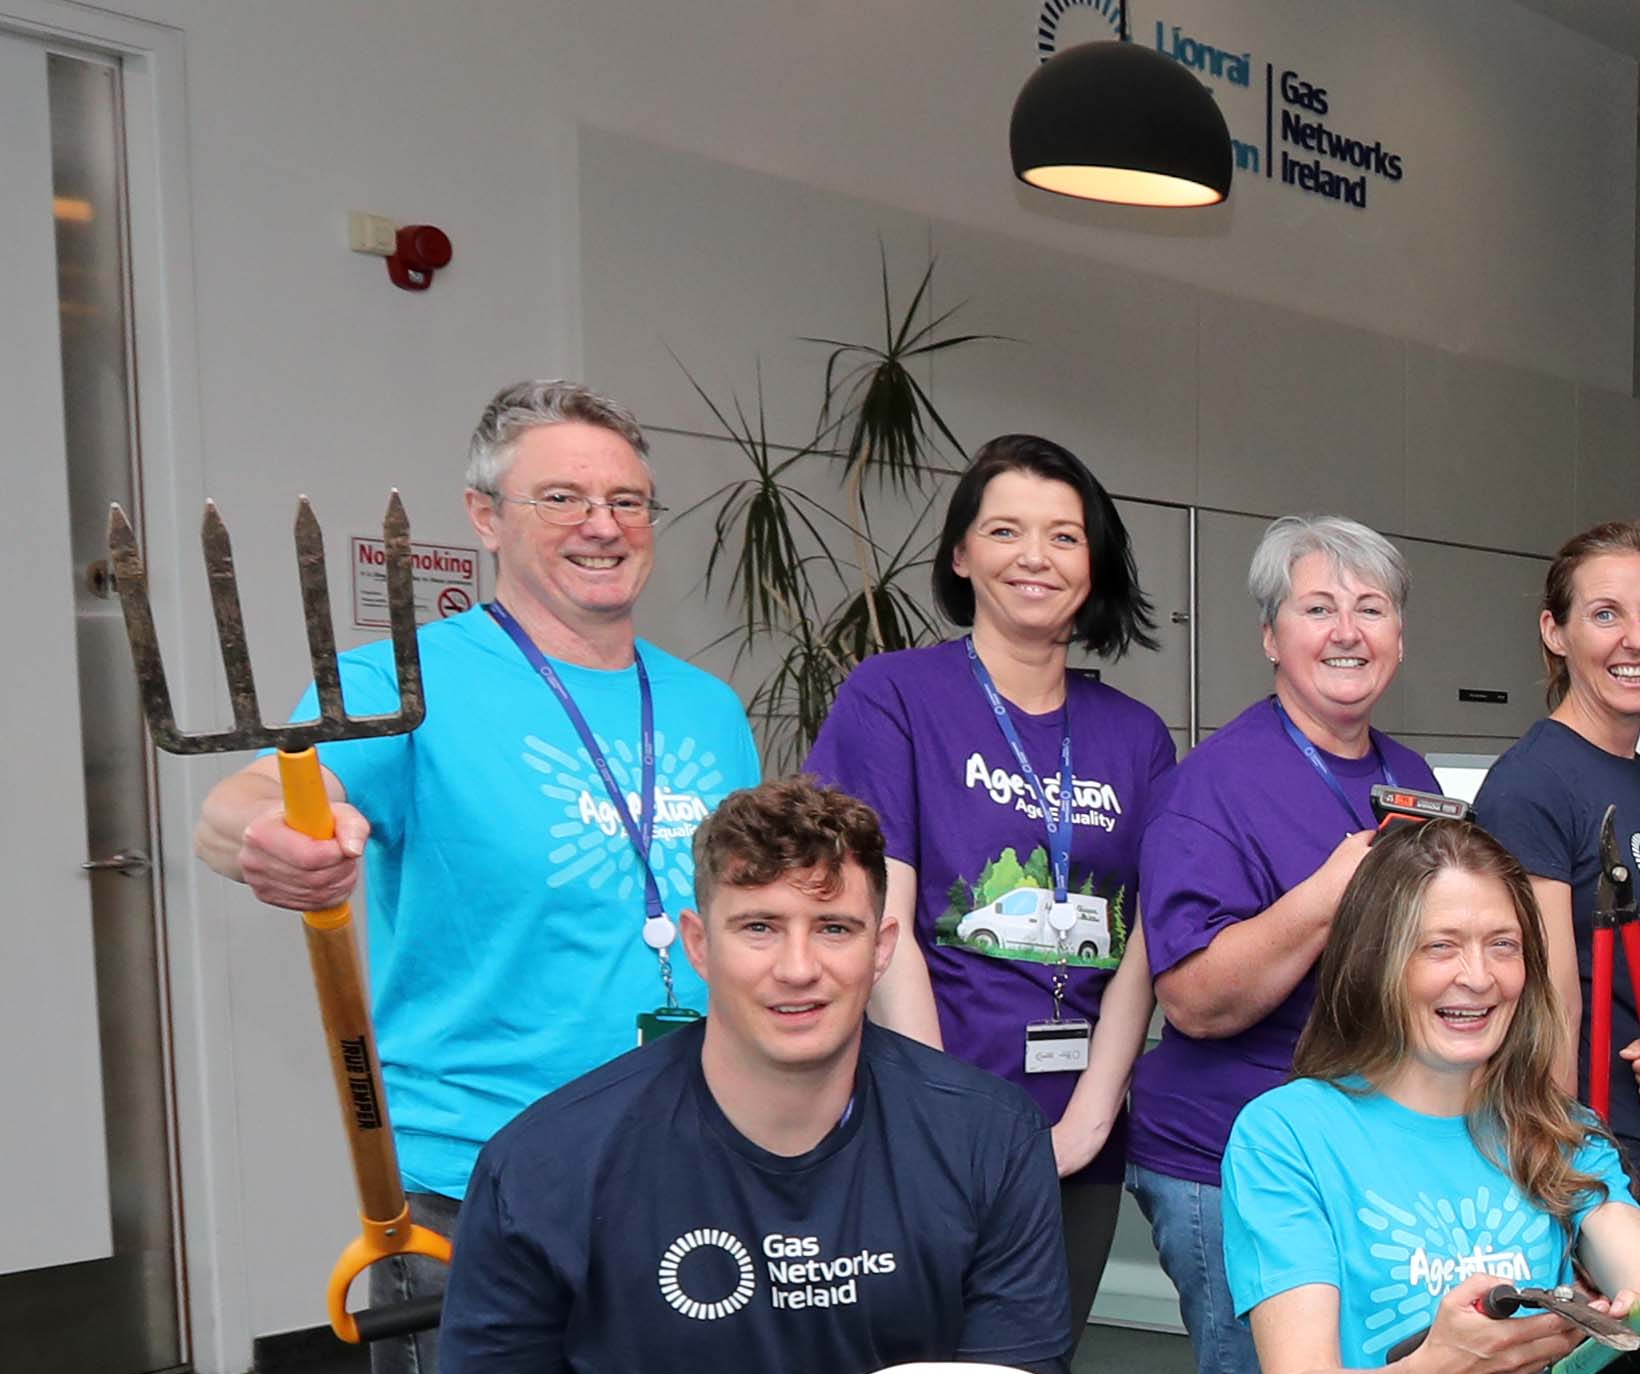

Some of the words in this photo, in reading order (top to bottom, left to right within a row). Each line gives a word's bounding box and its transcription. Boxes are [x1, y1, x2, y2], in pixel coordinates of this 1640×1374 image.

[1280, 71, 1329, 115] Gas
[1281, 110, 1403, 181] Networks
[1281, 151, 1366, 209] Ireland
[359, 543, 386, 566] No
[410, 549, 473, 579] moking
[341, 1035, 370, 1073] TRUE
[348, 1071, 383, 1130] TEMPER
[763, 1233, 821, 1258] Gas
